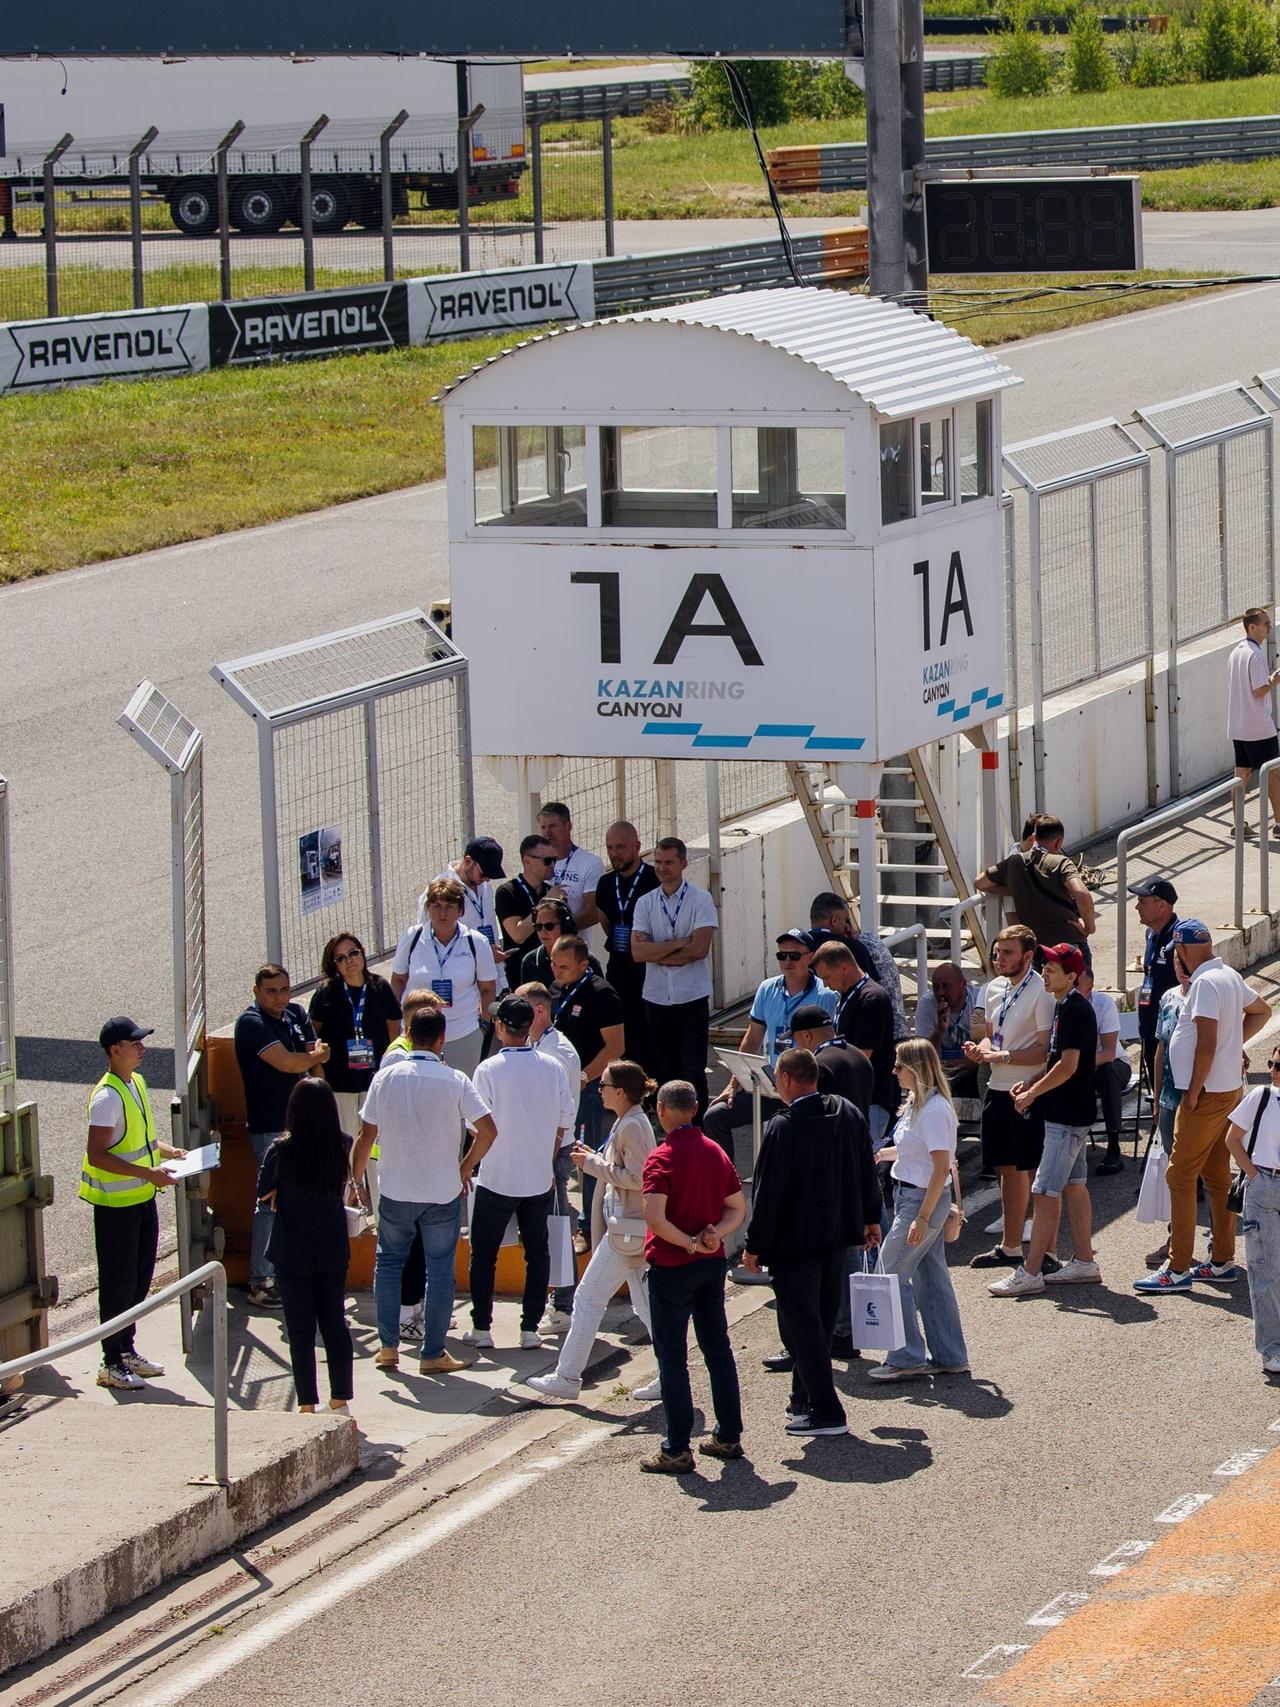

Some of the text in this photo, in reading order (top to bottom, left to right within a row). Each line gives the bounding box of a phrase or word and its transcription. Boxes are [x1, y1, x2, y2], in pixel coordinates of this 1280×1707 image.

[440, 282, 563, 321] RAVENOL
[244, 305, 377, 346] RAVENOL
[29, 328, 173, 369] RAVENOL
[570, 571, 765, 666] 1A
[913, 550, 974, 652] 1A
[596, 701, 682, 718] CANYON
[922, 682, 949, 704] CANYON
[1157, 1275, 1171, 1286] N
